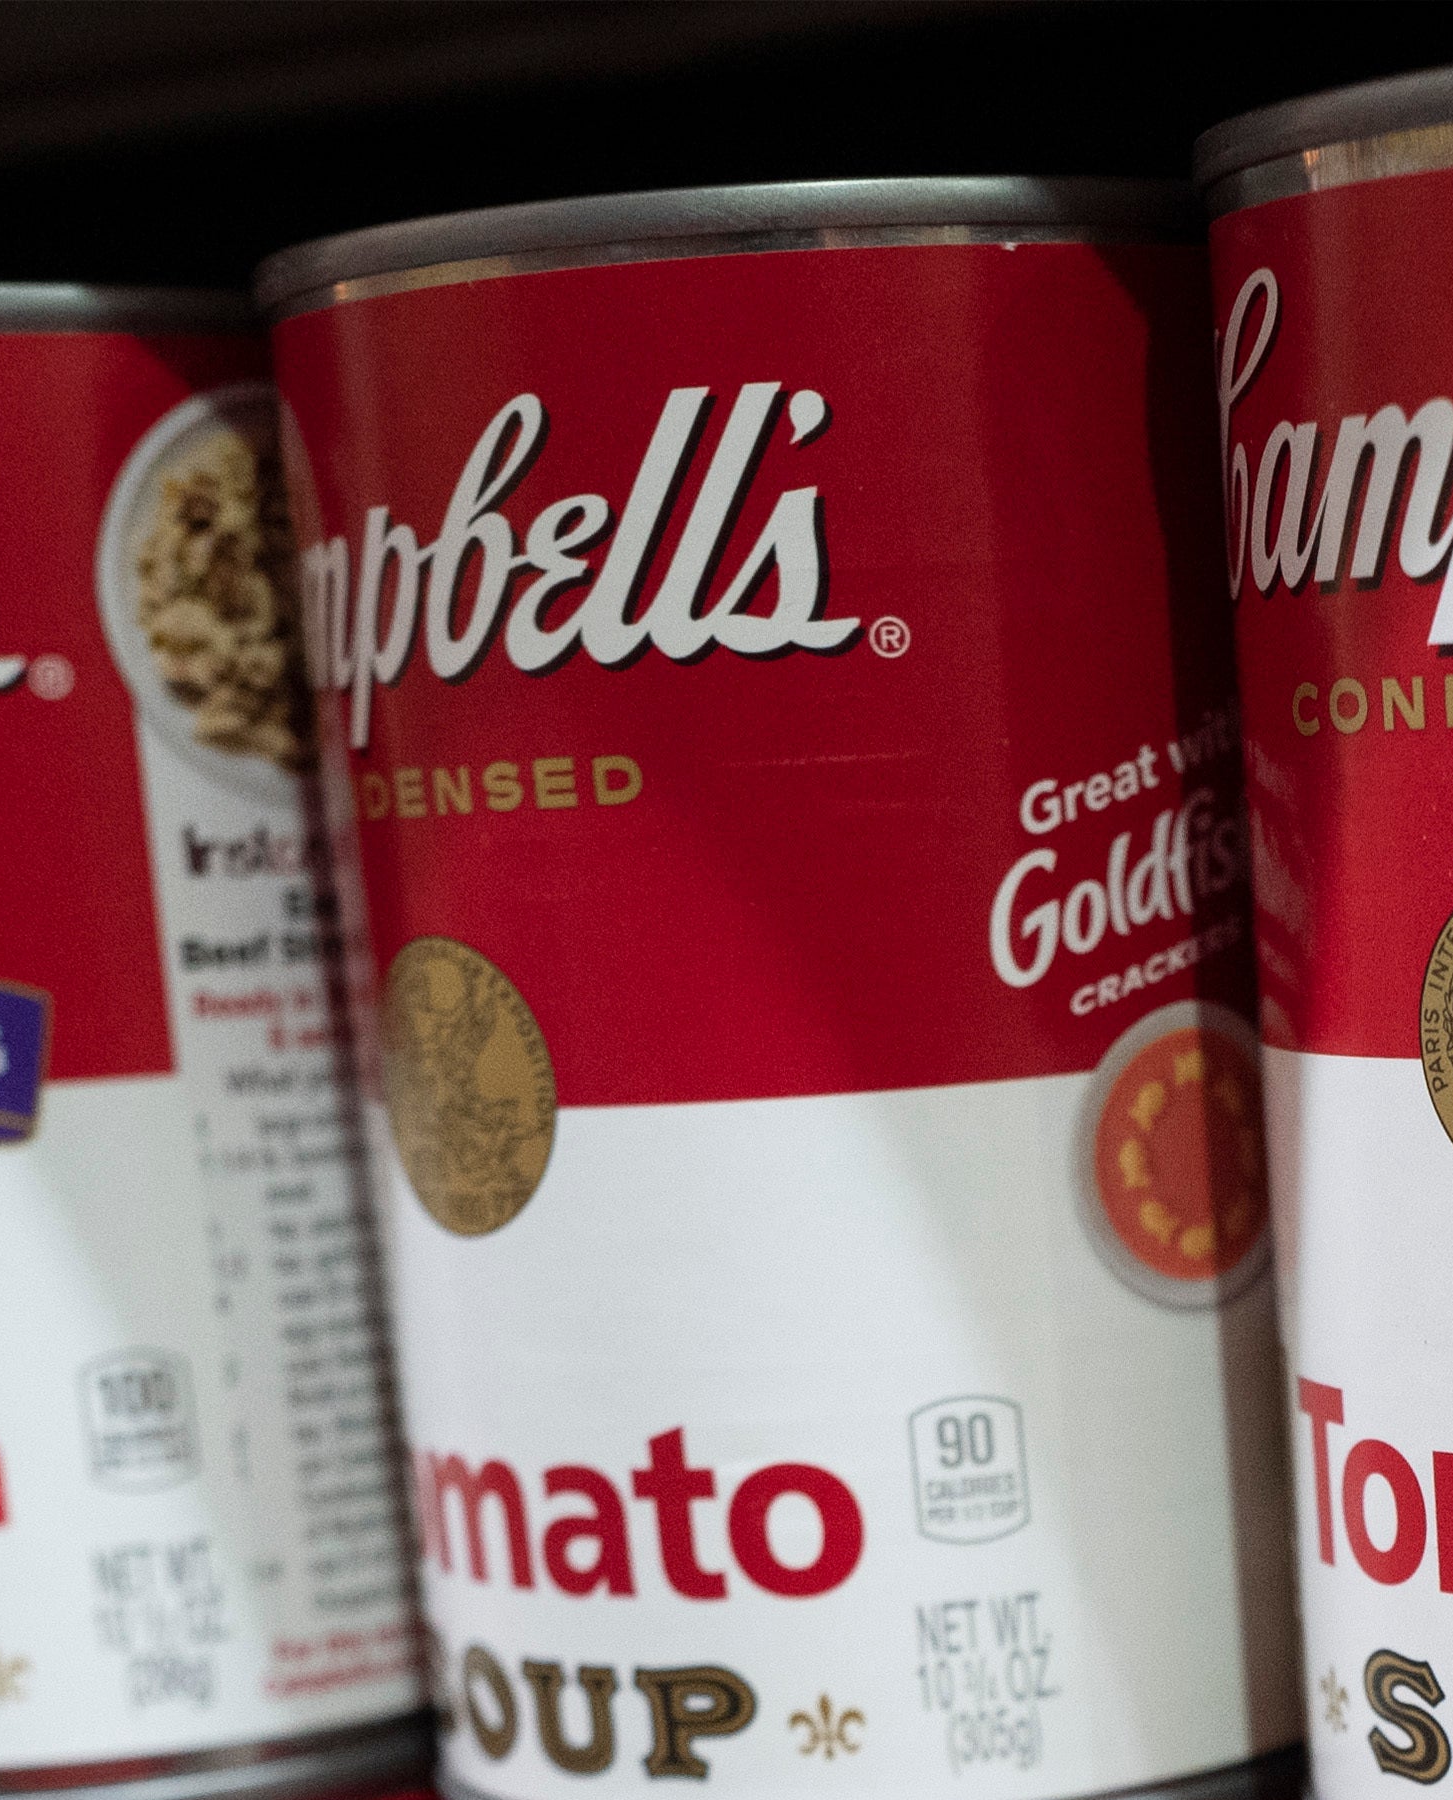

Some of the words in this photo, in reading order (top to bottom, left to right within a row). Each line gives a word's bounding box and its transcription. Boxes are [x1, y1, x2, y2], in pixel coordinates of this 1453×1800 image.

[1020, 745, 1159, 835] Great
[989, 788, 1246, 988] Goldfis
[1423, 1007, 1449, 1095] PARIS
[936, 1412, 996, 1469] 90
[916, 1600, 977, 1655] NET
[441, 1640, 760, 1780] OUP
